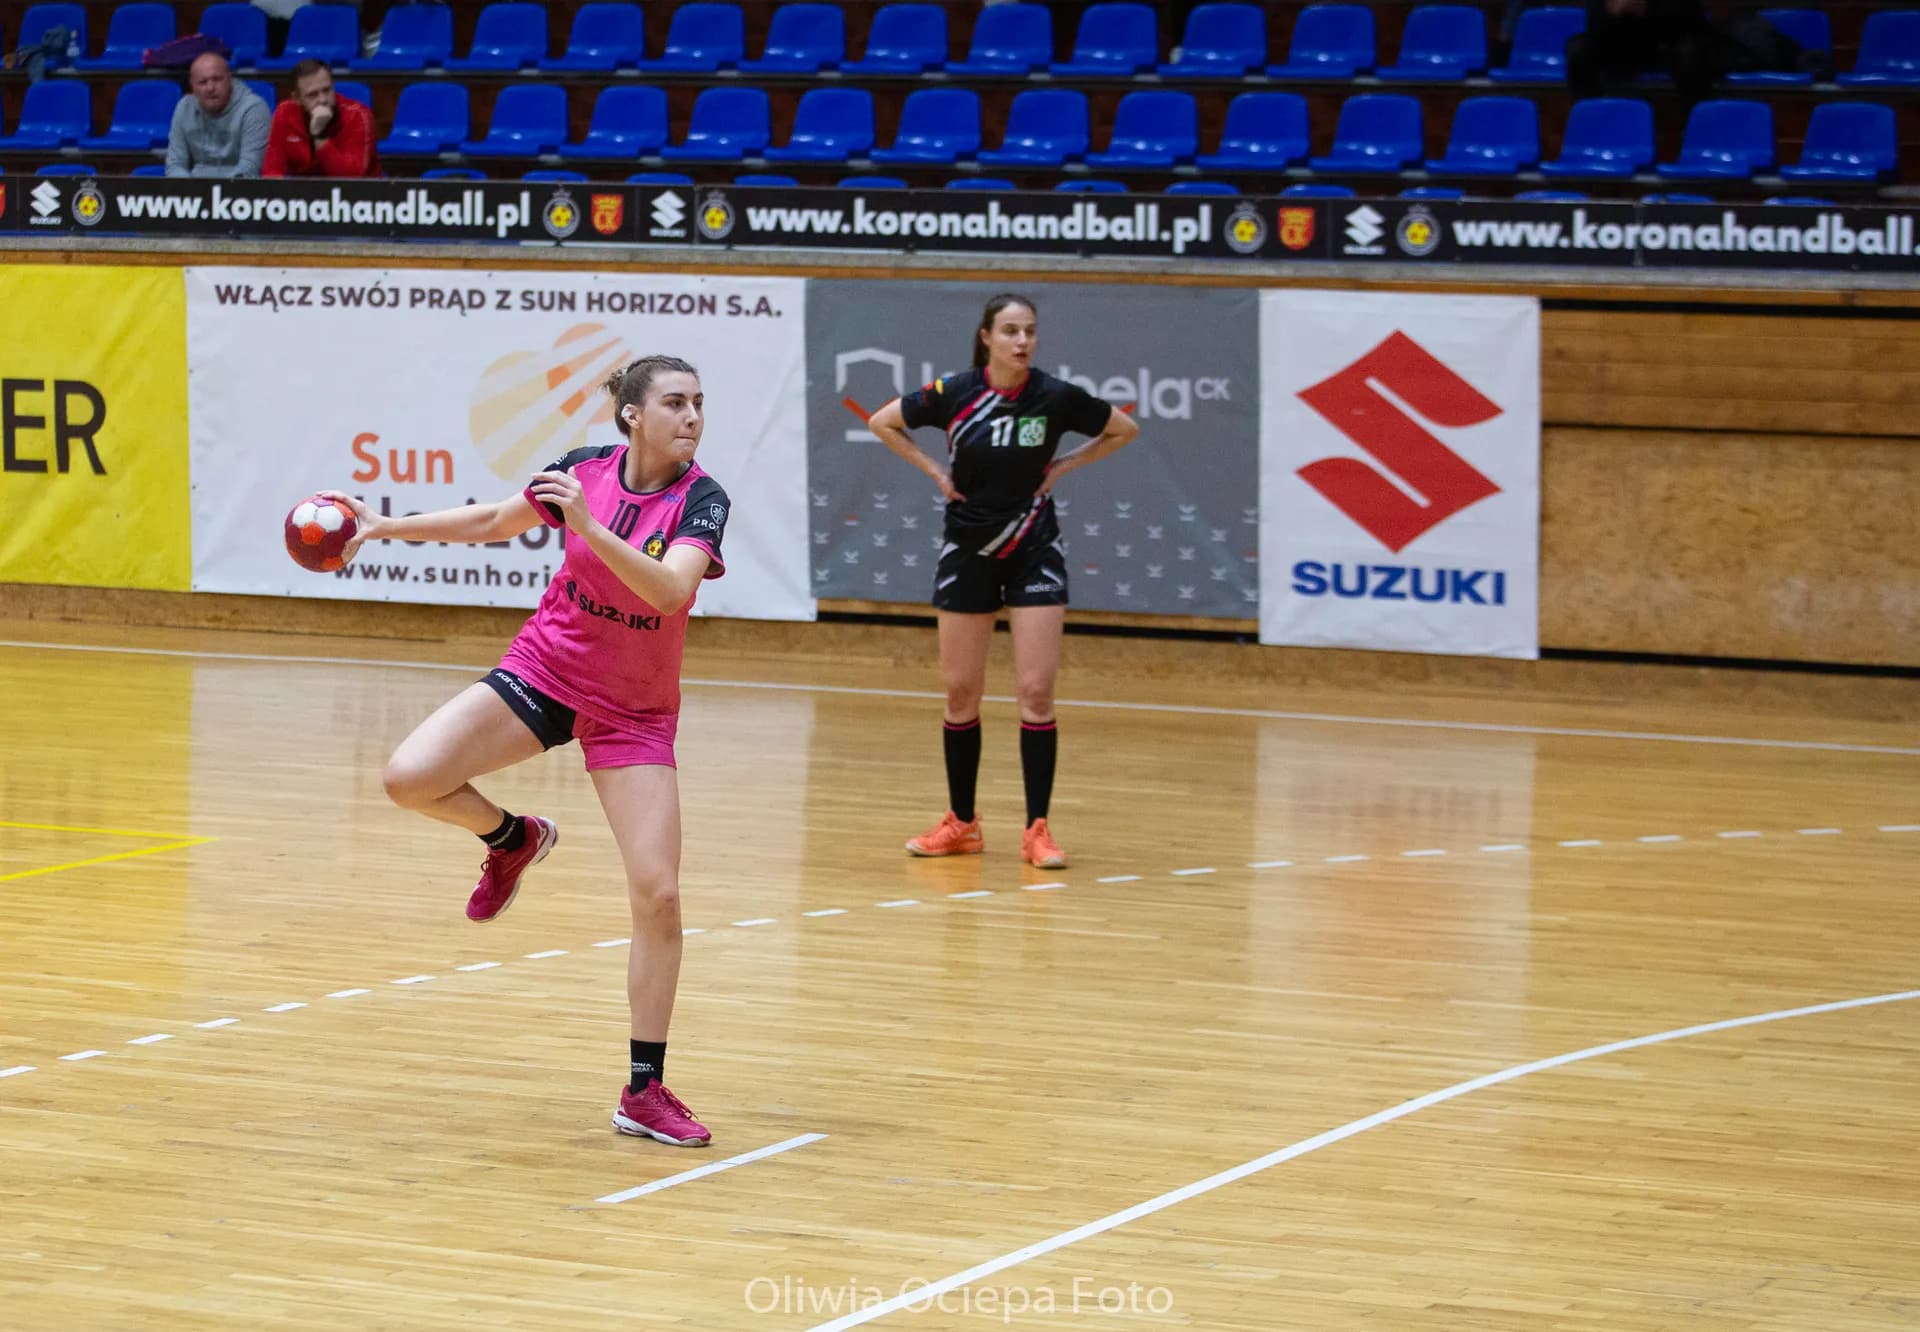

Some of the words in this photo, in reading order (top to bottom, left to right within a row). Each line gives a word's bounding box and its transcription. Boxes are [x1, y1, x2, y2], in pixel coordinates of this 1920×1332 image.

[117, 184, 531, 237] www.koronahandball.pl
[745, 198, 1211, 254] www.koronahandball.pl
[215, 284, 313, 313] WŁĄCZ
[321, 282, 400, 309] SWÓJ
[409, 288, 486, 317] PRĄD
[495, 289, 512, 311] Z
[520, 290, 576, 312] SUN
[586, 291, 716, 317] HORIZON
[726, 295, 782, 318] S.A.
[2, 378, 107, 475] ER
[990, 415, 1014, 447] 17
[352, 432, 453, 484] Sun
[607, 500, 641, 541] 10
[692, 517, 719, 531] PRO
[335, 563, 550, 587] www.sunhori
[1291, 560, 1505, 607] SUZUKI
[578, 594, 662, 630] SUZUKI
